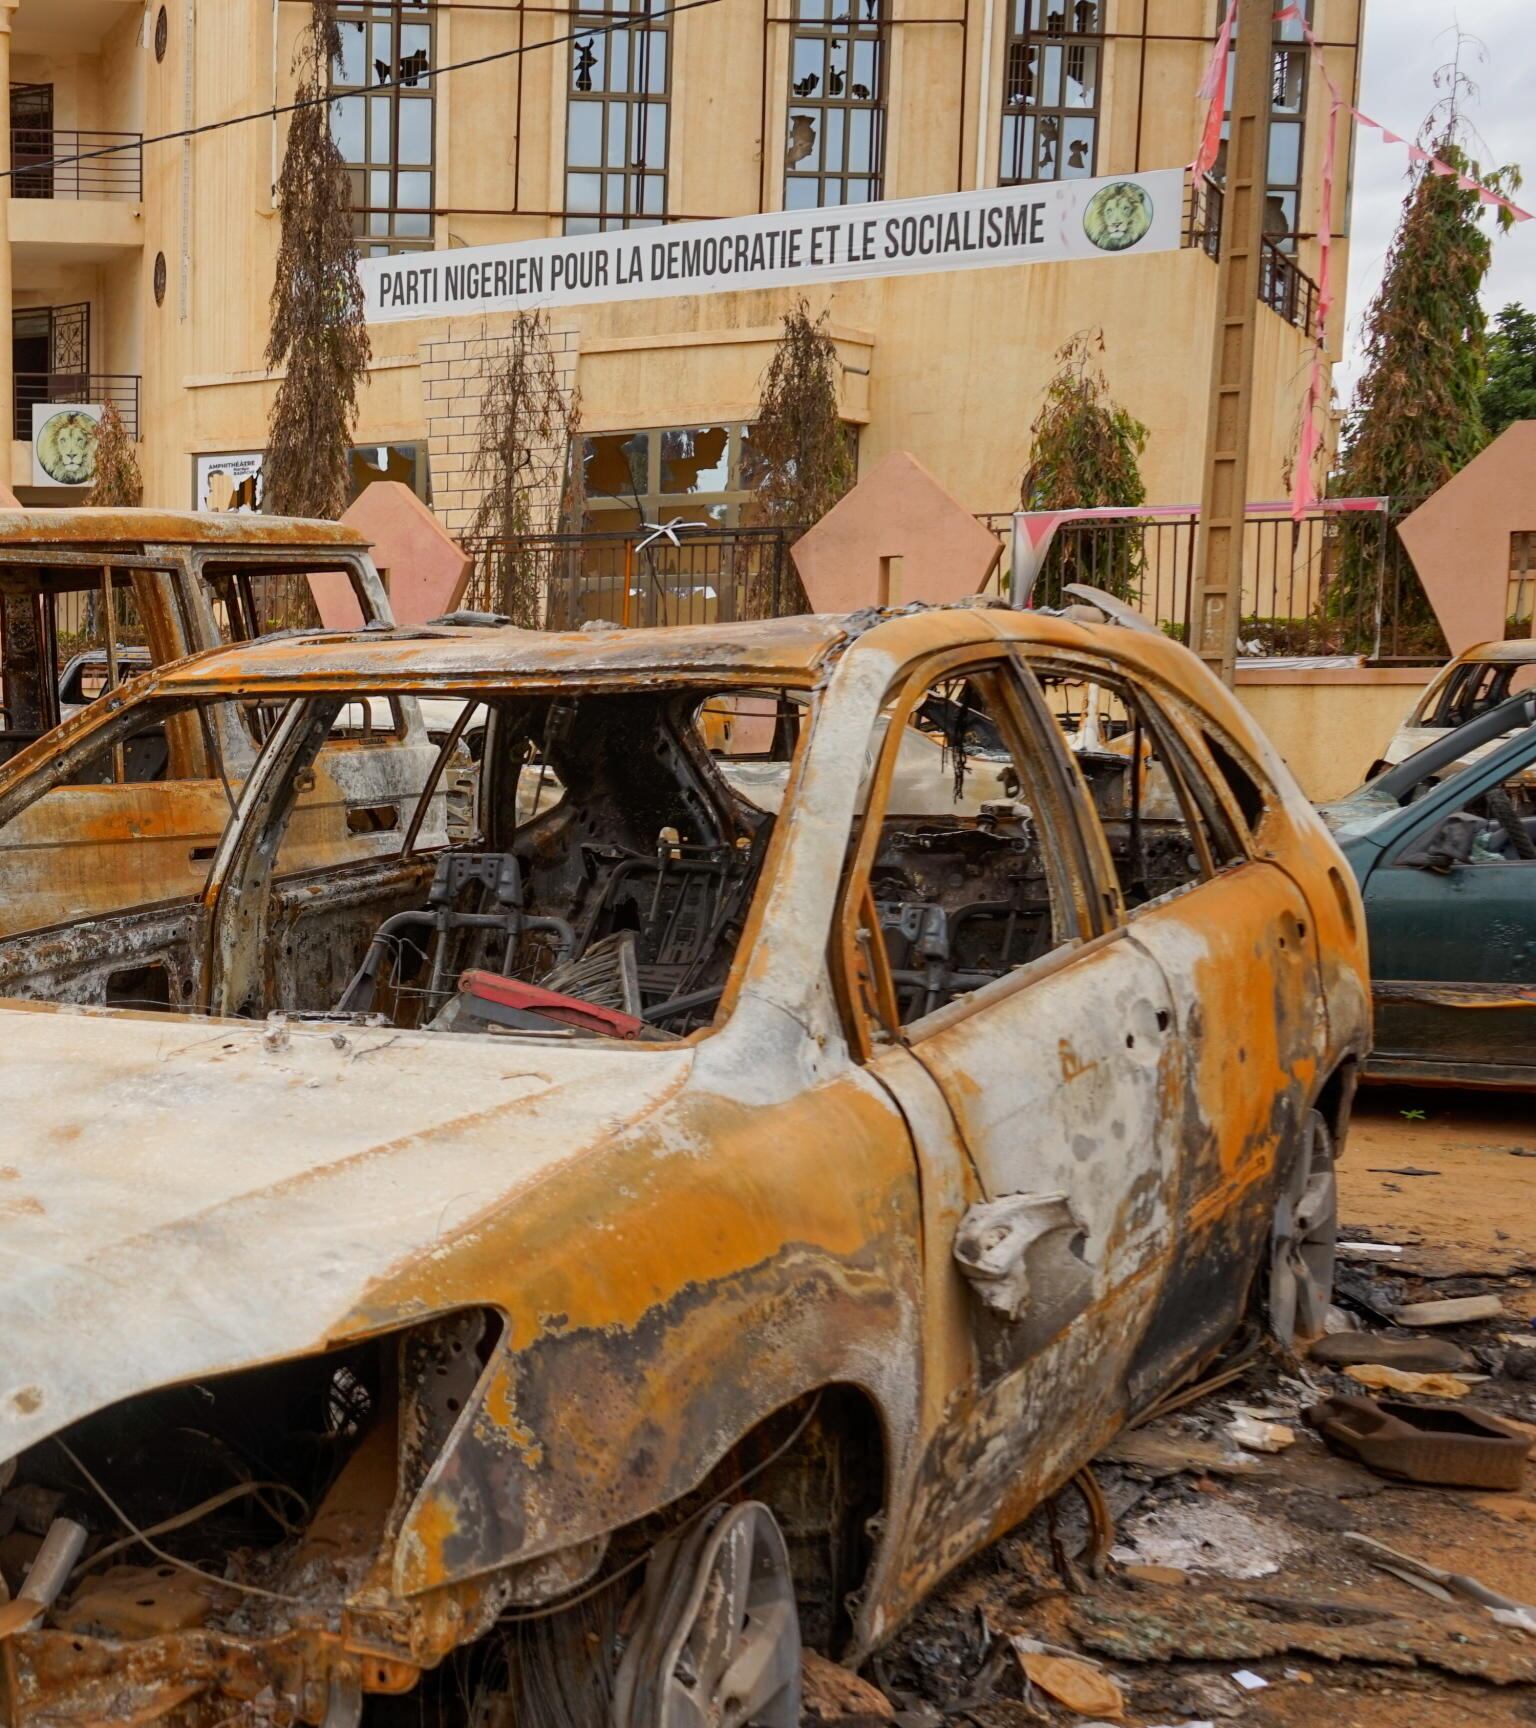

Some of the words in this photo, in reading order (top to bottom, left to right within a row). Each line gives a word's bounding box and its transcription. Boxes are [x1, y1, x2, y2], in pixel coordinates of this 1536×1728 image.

[379, 267, 438, 308] PARTI
[444, 256, 544, 302] NIGERIEN
[550, 249, 609, 292] POUR
[615, 245, 644, 286] LA
[650, 227, 803, 282] DEMOCRATIE
[810, 224, 841, 265] ET
[847, 220, 877, 262] LE
[884, 202, 1047, 259] SOCIALISME
